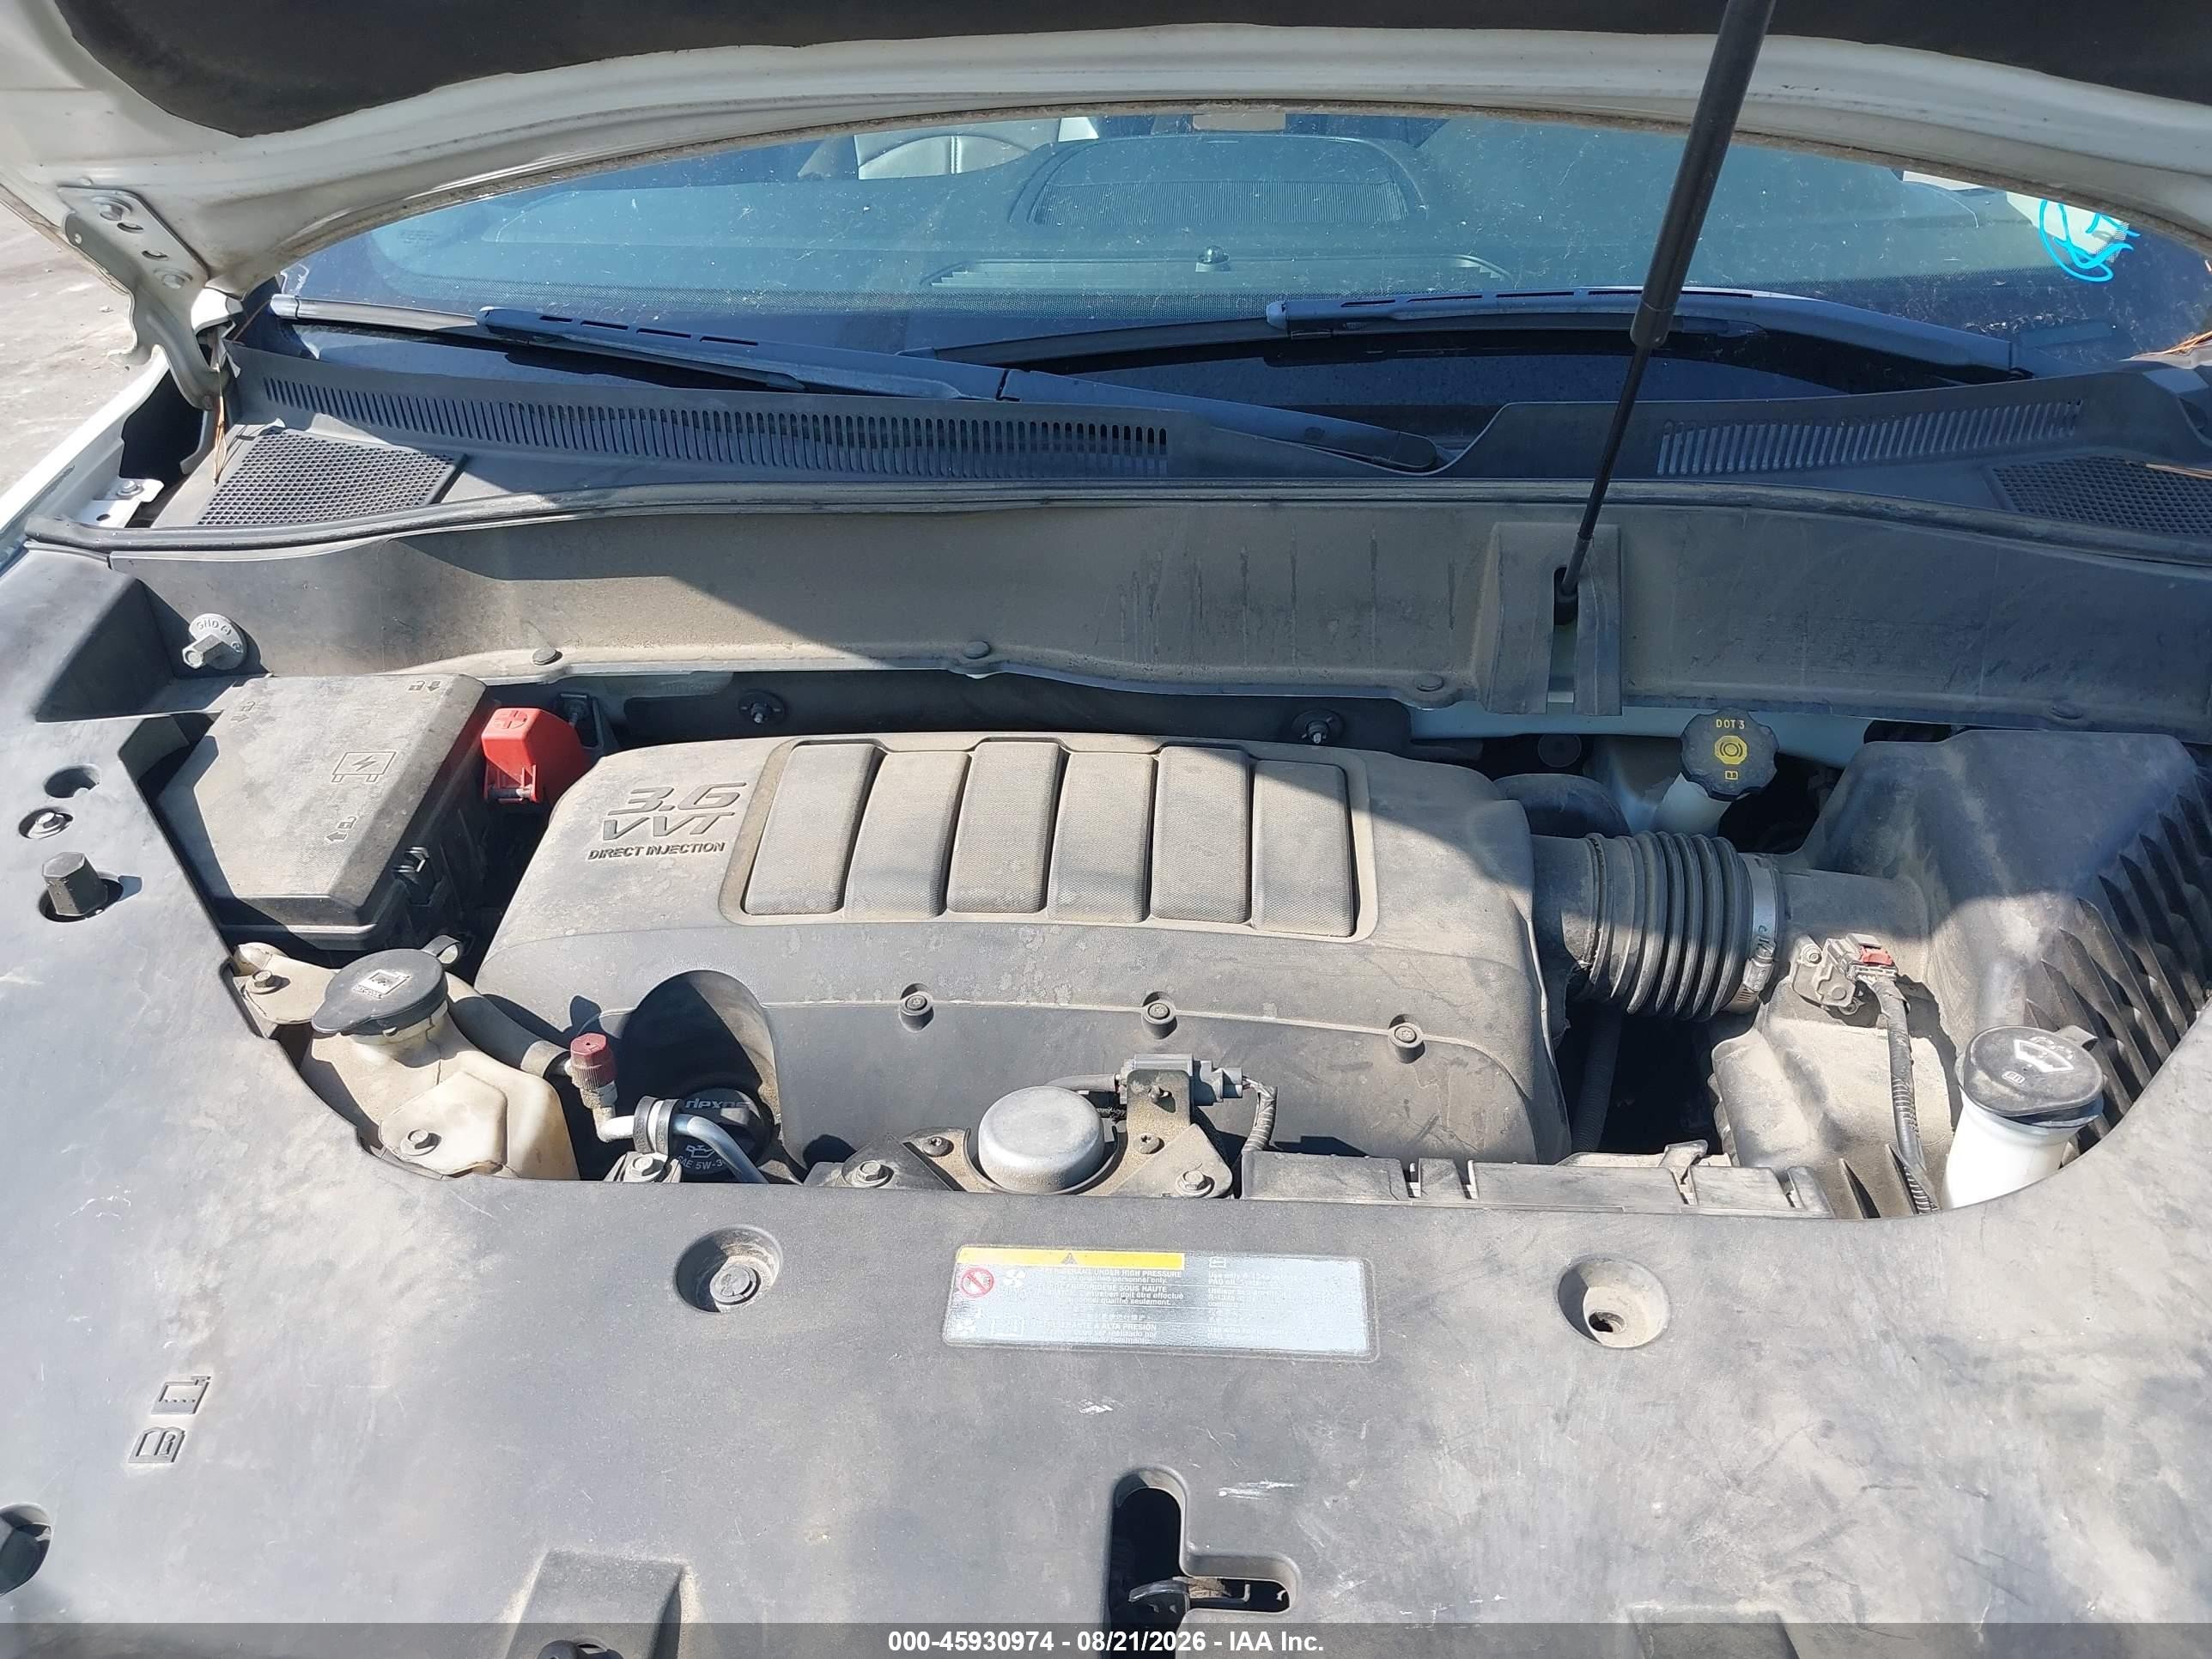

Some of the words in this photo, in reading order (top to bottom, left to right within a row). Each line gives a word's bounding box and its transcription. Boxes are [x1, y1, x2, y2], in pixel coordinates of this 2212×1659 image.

[1716, 719, 1736, 728] DOT
[1738, 720, 1745, 730] 3
[608, 782, 746, 816] 3.6
[603, 811, 735, 841] VVT
[587, 846, 644, 860] DIRECT
[645, 842, 726, 855] INJECTION
[678, 1154, 694, 1169] SAE
[696, 1158, 726, 1170] 5W-3
[1094, 1268, 1121, 1277] UNDER
[1121, 1269, 1141, 1278] HIGH
[1142, 1270, 1182, 1279] PRESSURE
[1112, 1276, 1150, 1285] personnel
[1151, 1276, 1168, 1285] only.
[1119, 1284, 1140, 1292] SOUS
[1141, 1285, 1168, 1293] HAUTE
